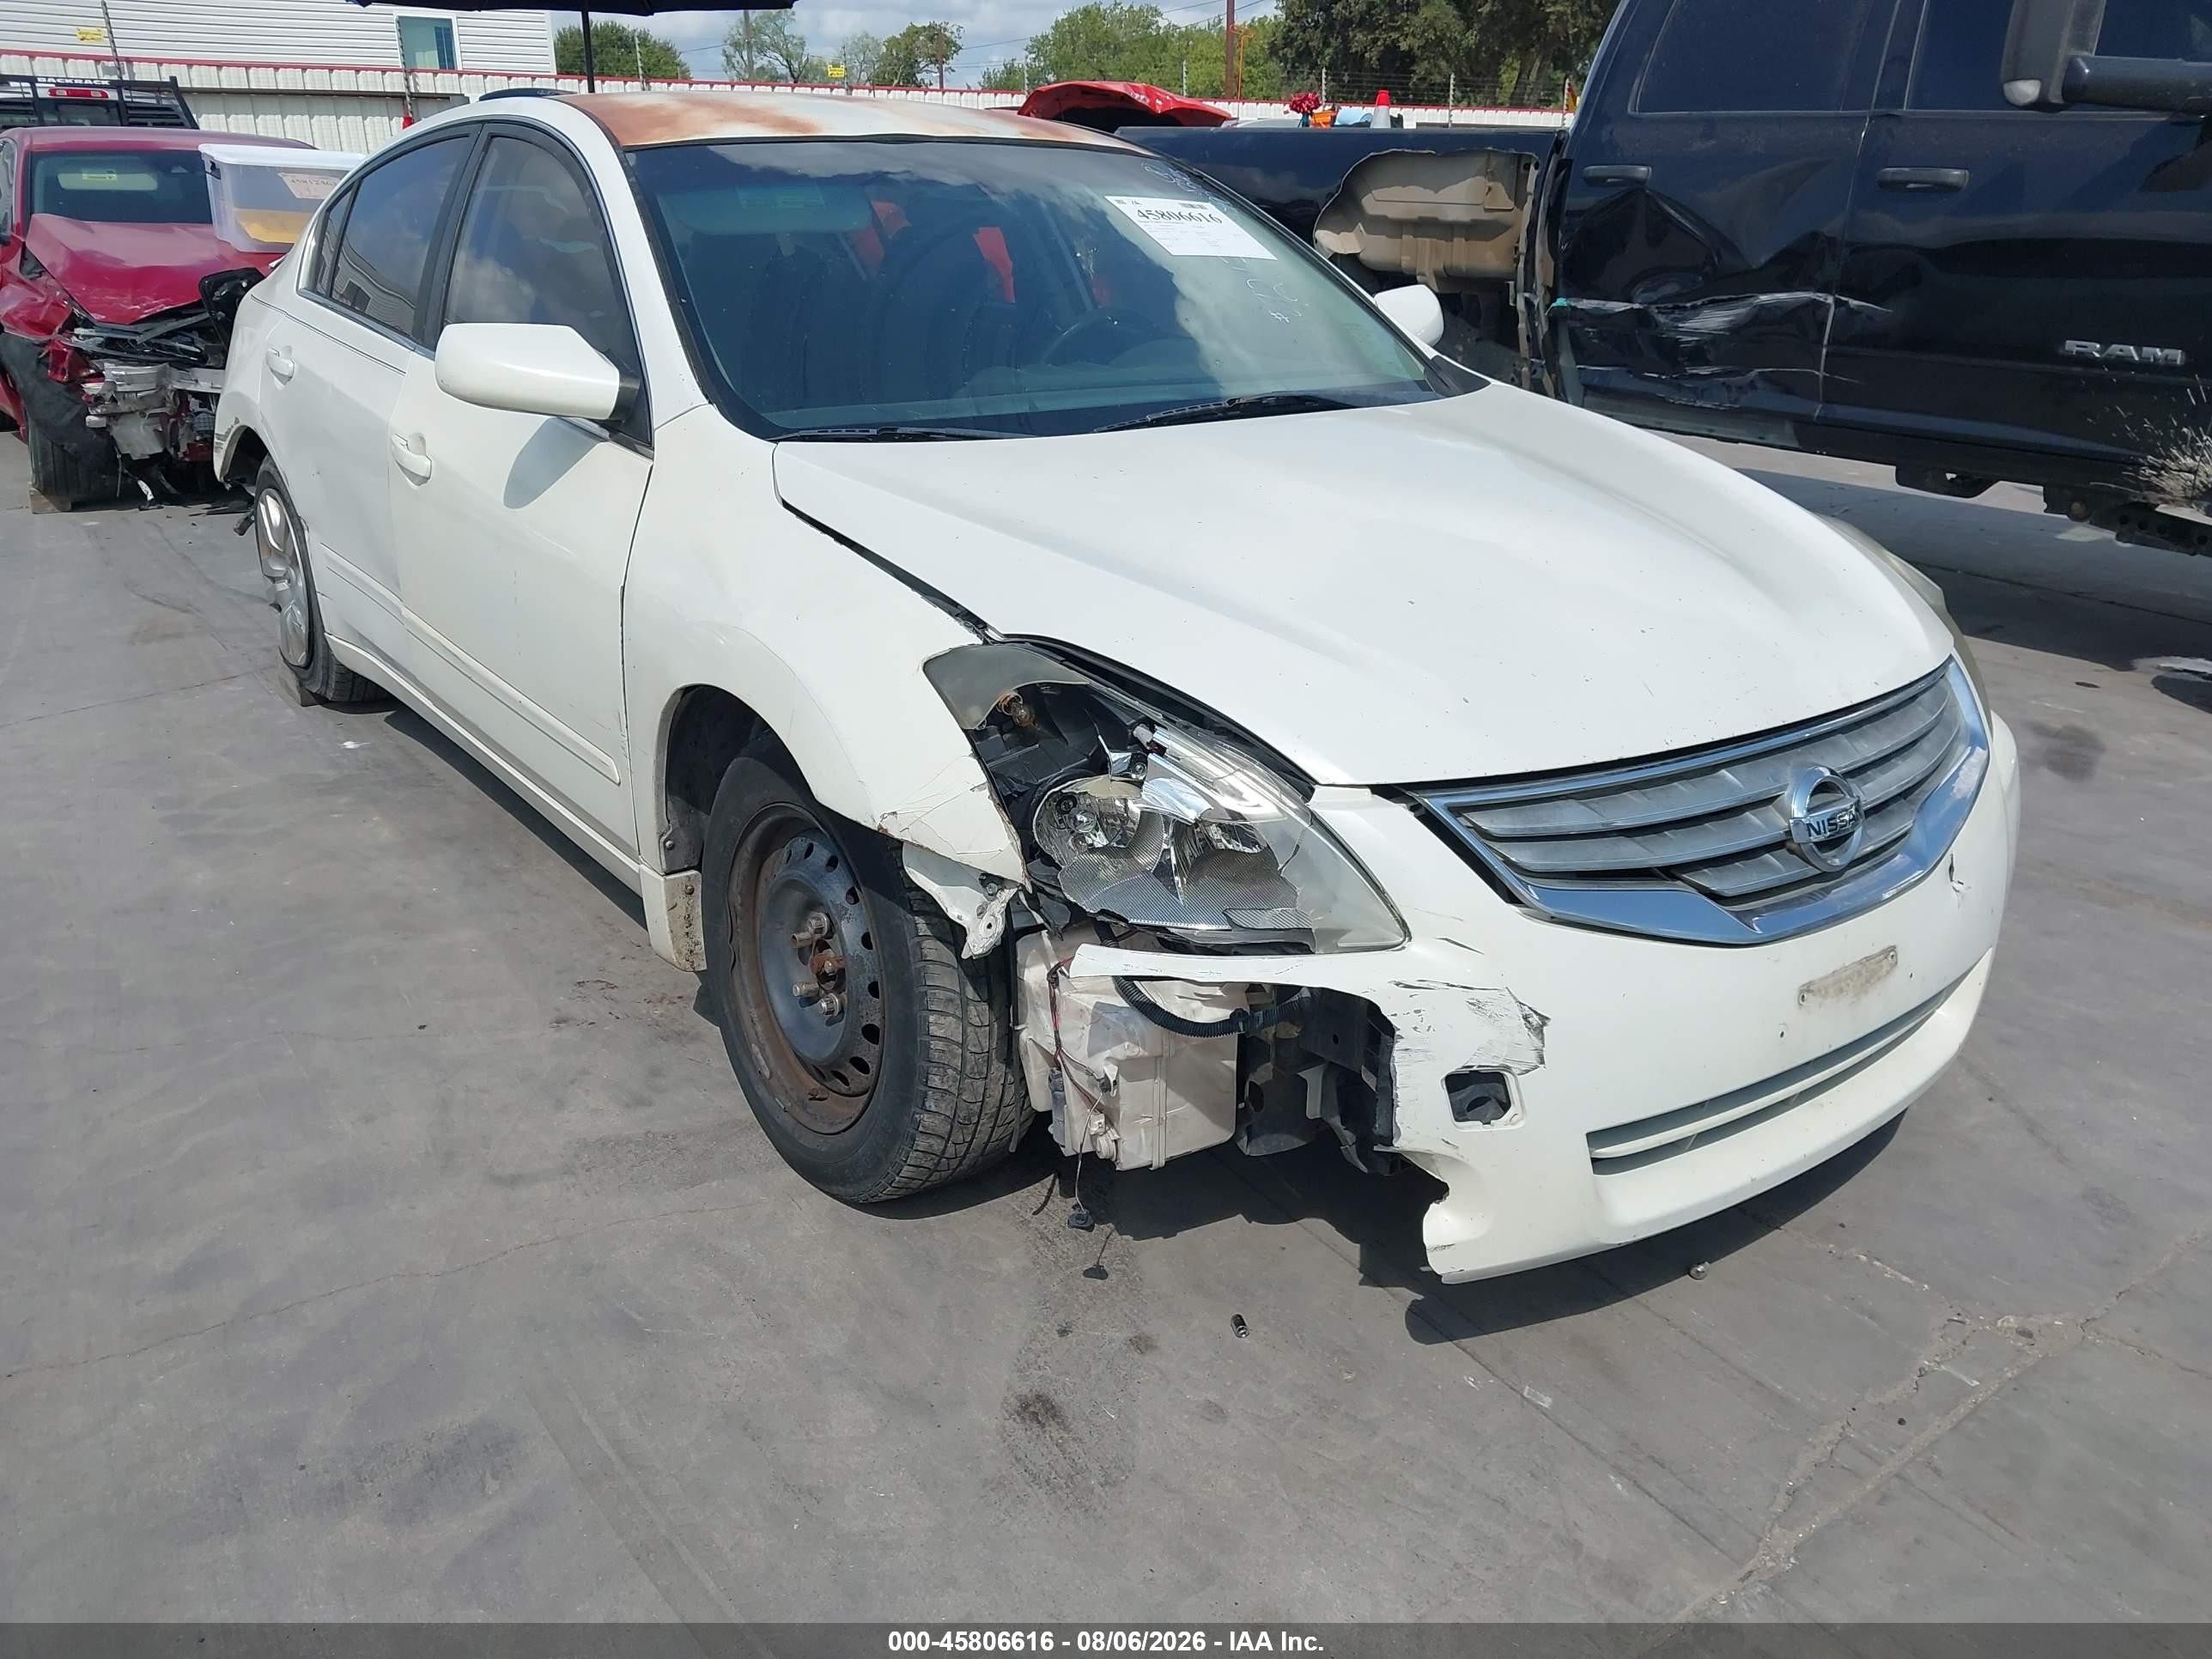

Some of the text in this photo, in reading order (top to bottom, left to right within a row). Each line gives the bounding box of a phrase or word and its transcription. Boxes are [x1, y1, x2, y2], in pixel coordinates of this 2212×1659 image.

[1137, 209, 1223, 224] 45806616
[2064, 339, 2184, 365] RAM
[1807, 805, 1859, 837] NISSA
